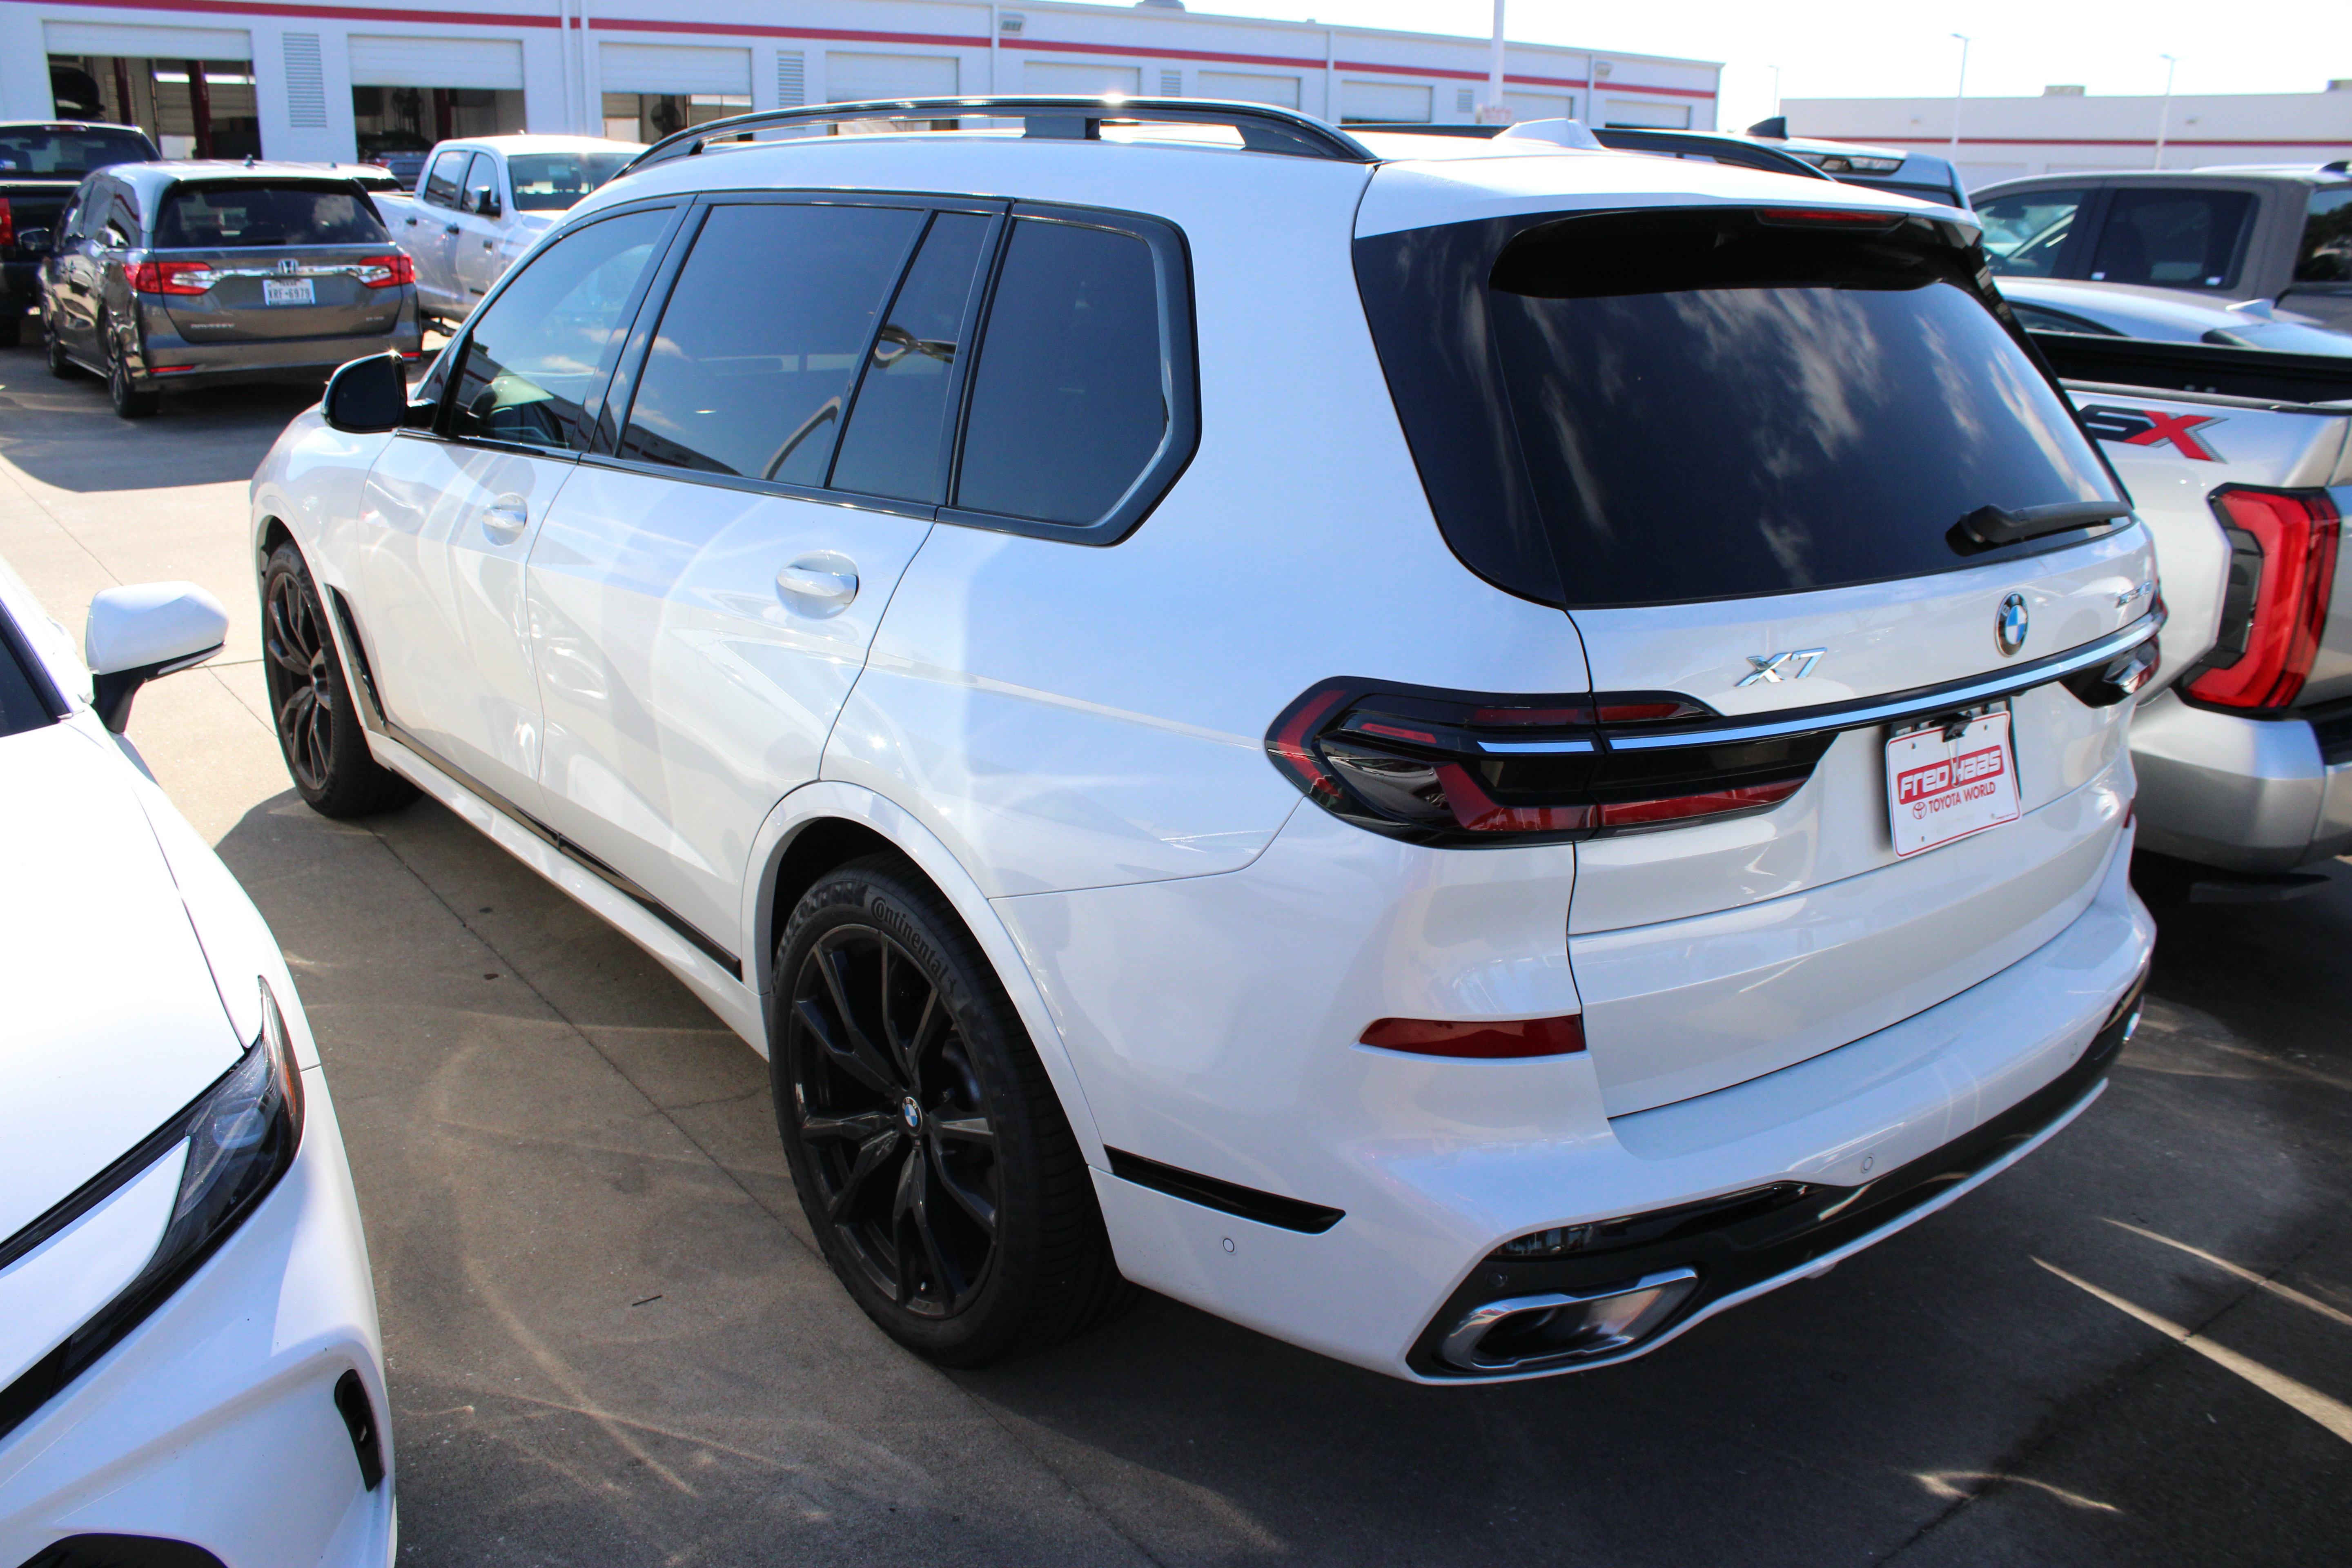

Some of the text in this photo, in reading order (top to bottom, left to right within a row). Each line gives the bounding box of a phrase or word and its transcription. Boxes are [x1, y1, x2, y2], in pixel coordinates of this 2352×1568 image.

[1734, 647, 1827, 687] X7
[1929, 782, 1996, 813] TOYOTA WORLD
[871, 897, 949, 980] Continental
